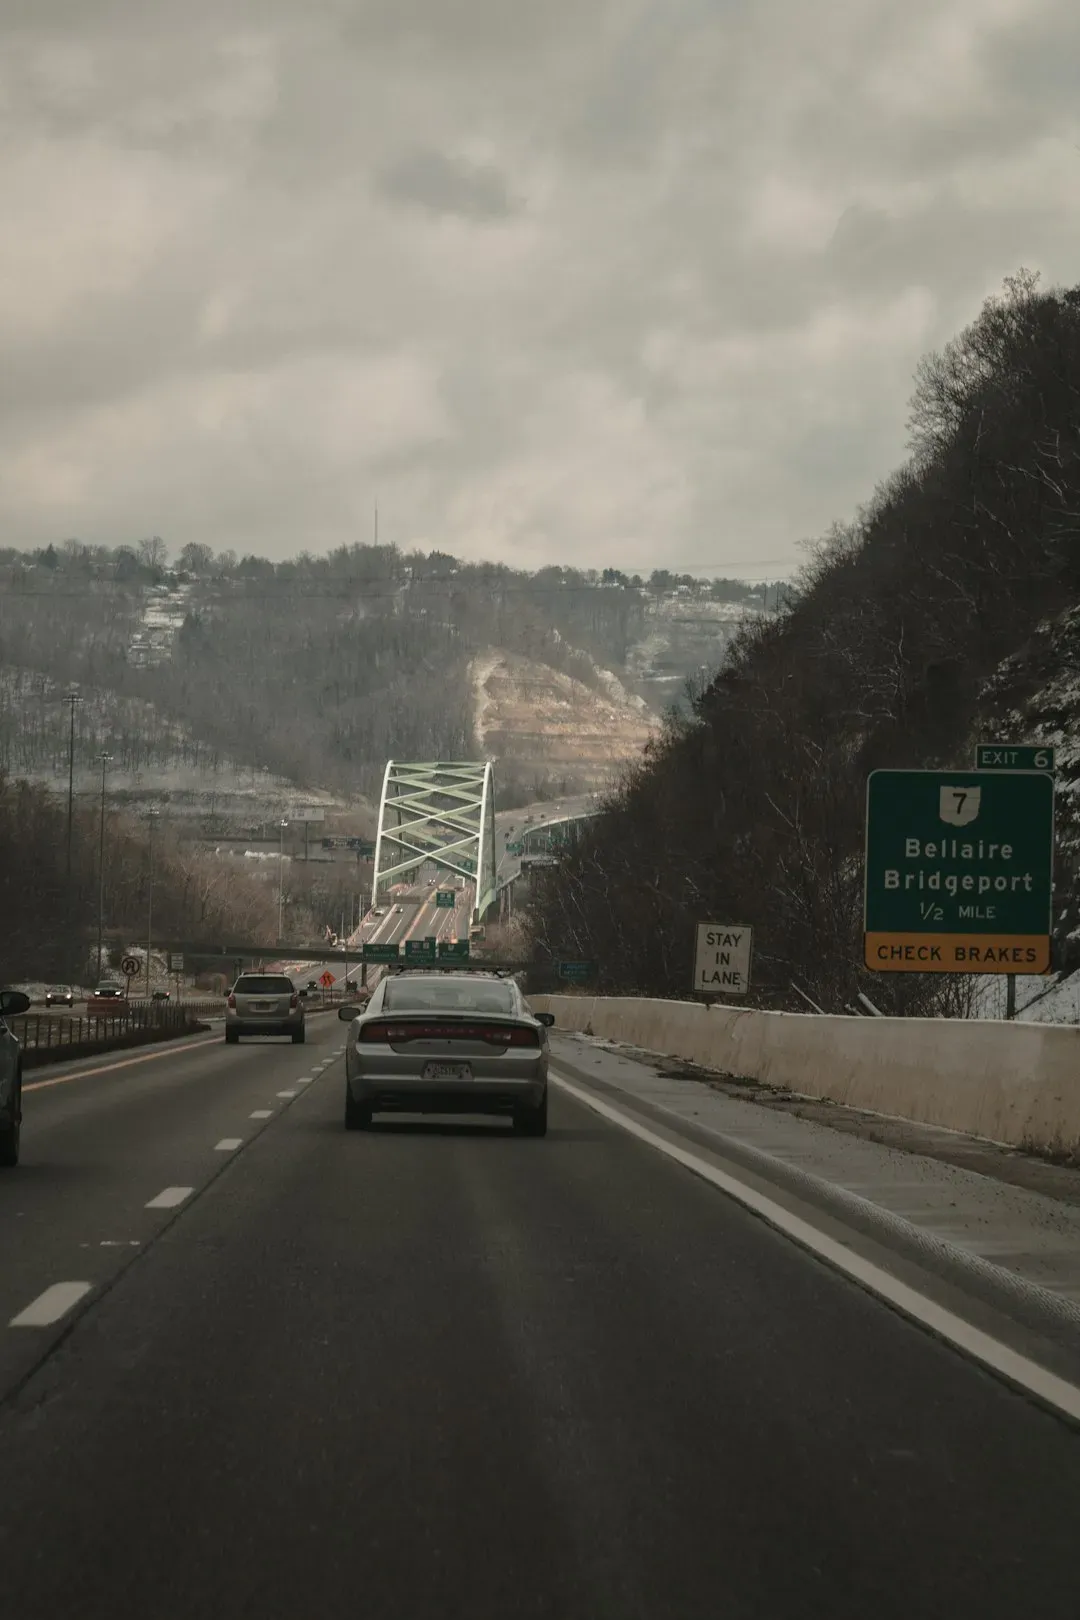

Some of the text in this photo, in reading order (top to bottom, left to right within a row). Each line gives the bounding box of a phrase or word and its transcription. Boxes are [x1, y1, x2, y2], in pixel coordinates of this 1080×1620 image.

[981, 750, 1048, 768] EXIT 6
[952, 792, 968, 815] 7
[905, 838, 1013, 859] Bellaire
[884, 869, 1033, 896] Bridgeport
[959, 905, 996, 919] MILE
[706, 932, 742, 947] STAY
[715, 952, 730, 965] IN
[877, 946, 1037, 963] CHECK BRAKES
[702, 969, 741, 986] LANE
